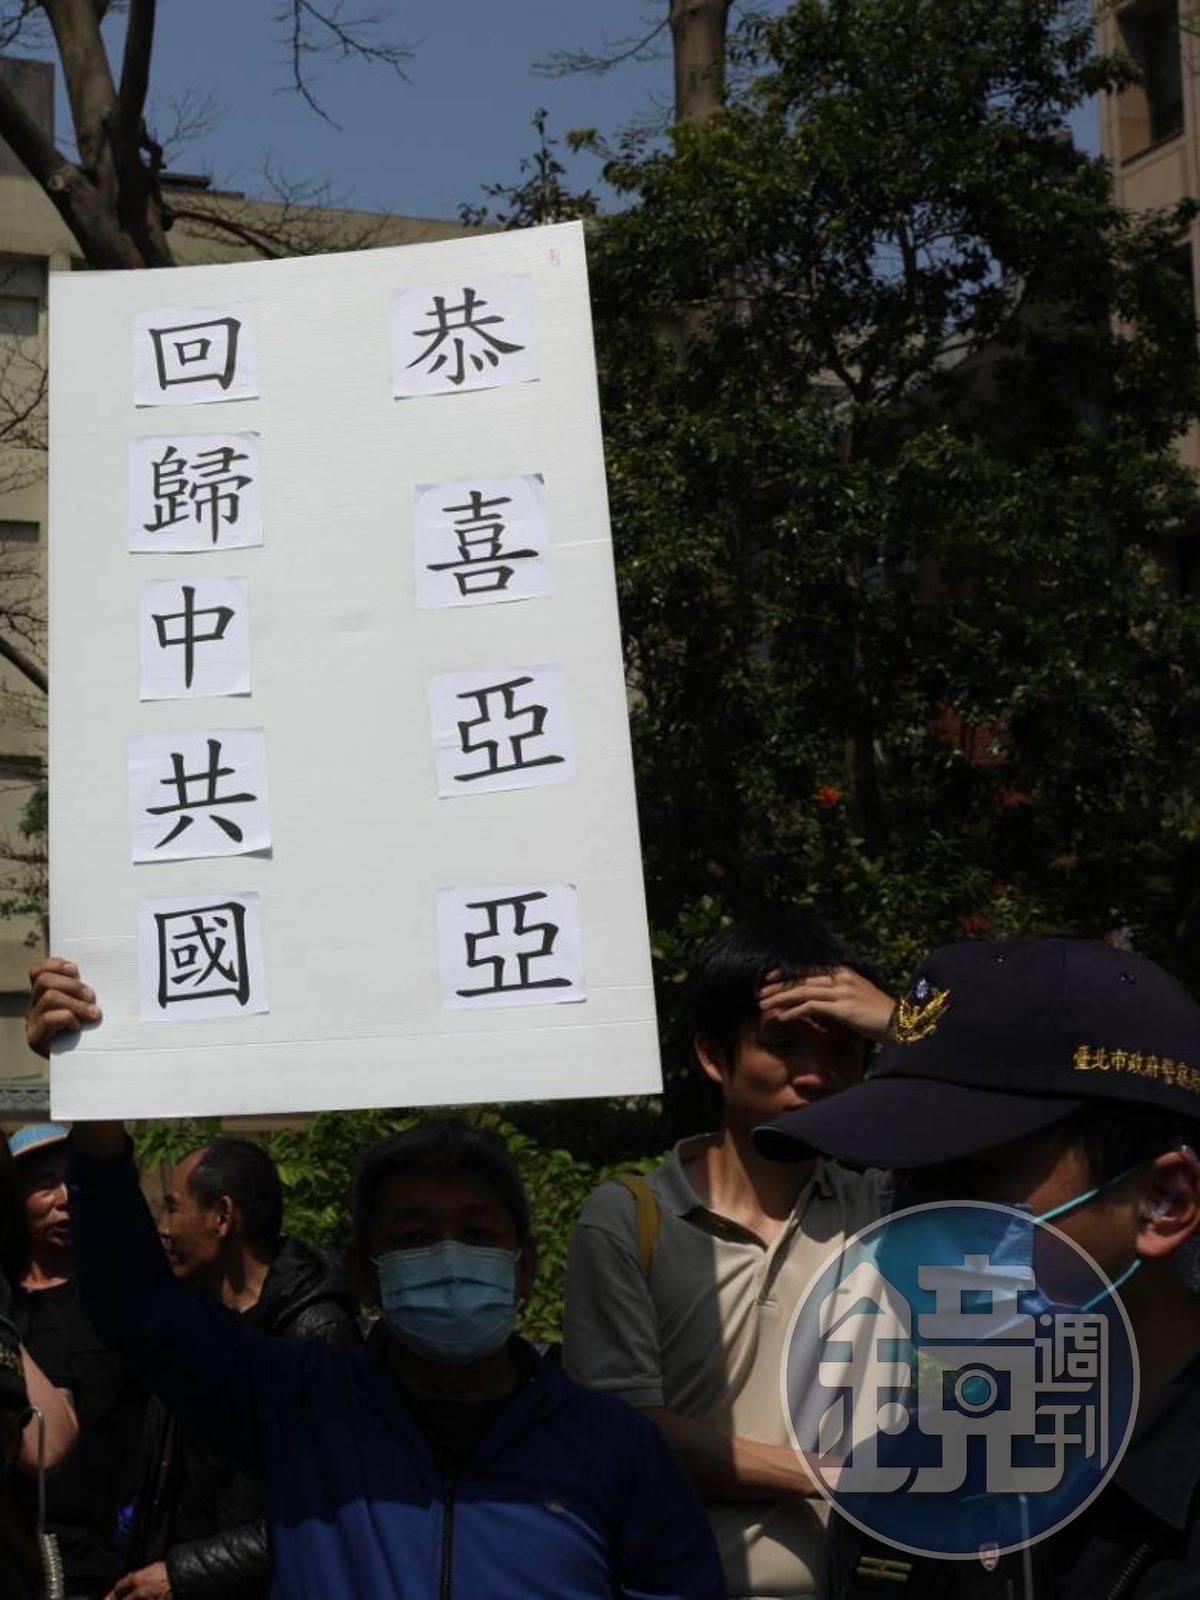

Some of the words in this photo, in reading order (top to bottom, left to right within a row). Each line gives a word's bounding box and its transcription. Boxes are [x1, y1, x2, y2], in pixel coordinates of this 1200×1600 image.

[143, 316, 257, 1008] 回歸中共國
[405, 286, 573, 998] 恭喜亞亞
